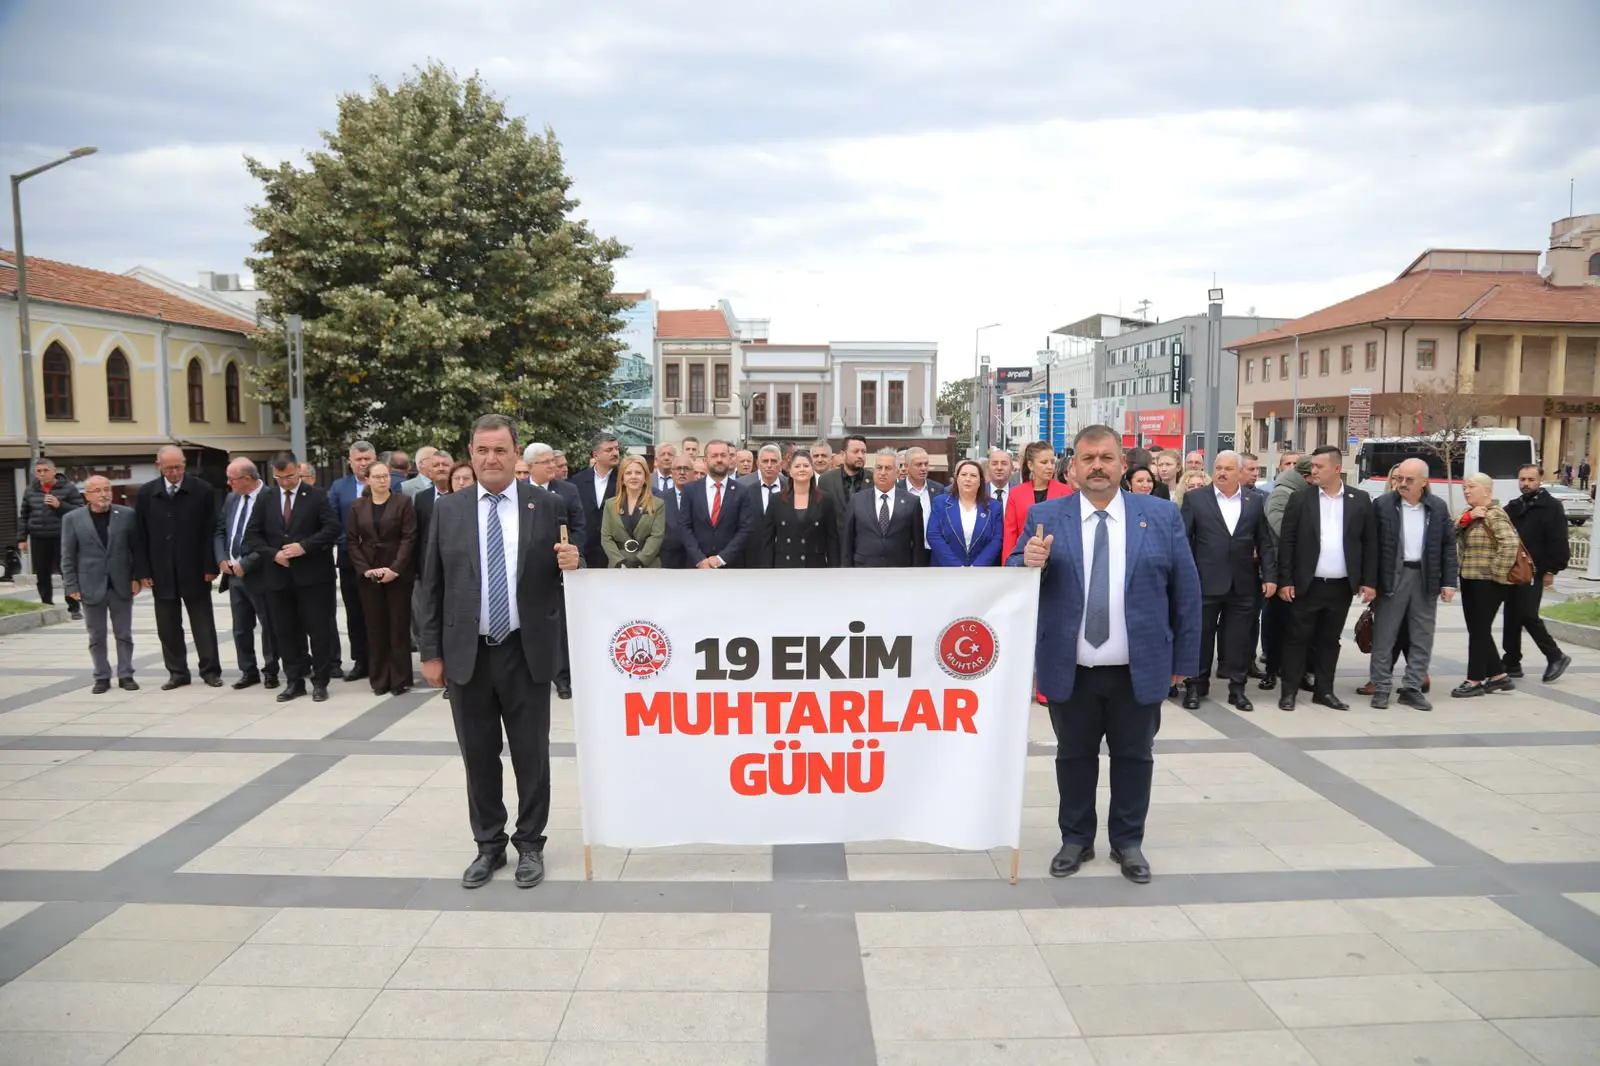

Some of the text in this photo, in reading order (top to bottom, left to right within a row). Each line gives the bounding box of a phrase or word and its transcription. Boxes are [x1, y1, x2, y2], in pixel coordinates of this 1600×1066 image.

[1173, 343, 1181, 403] HOTEL
[614, 621, 635, 637] MAHALLE
[695, 621, 913, 680] 19 EKİM
[960, 624, 978, 634] T.C.
[946, 652, 985, 670] MUHTAR
[625, 689, 979, 737] MUHTARLAR
[729, 738, 885, 796] GÜNÜ
